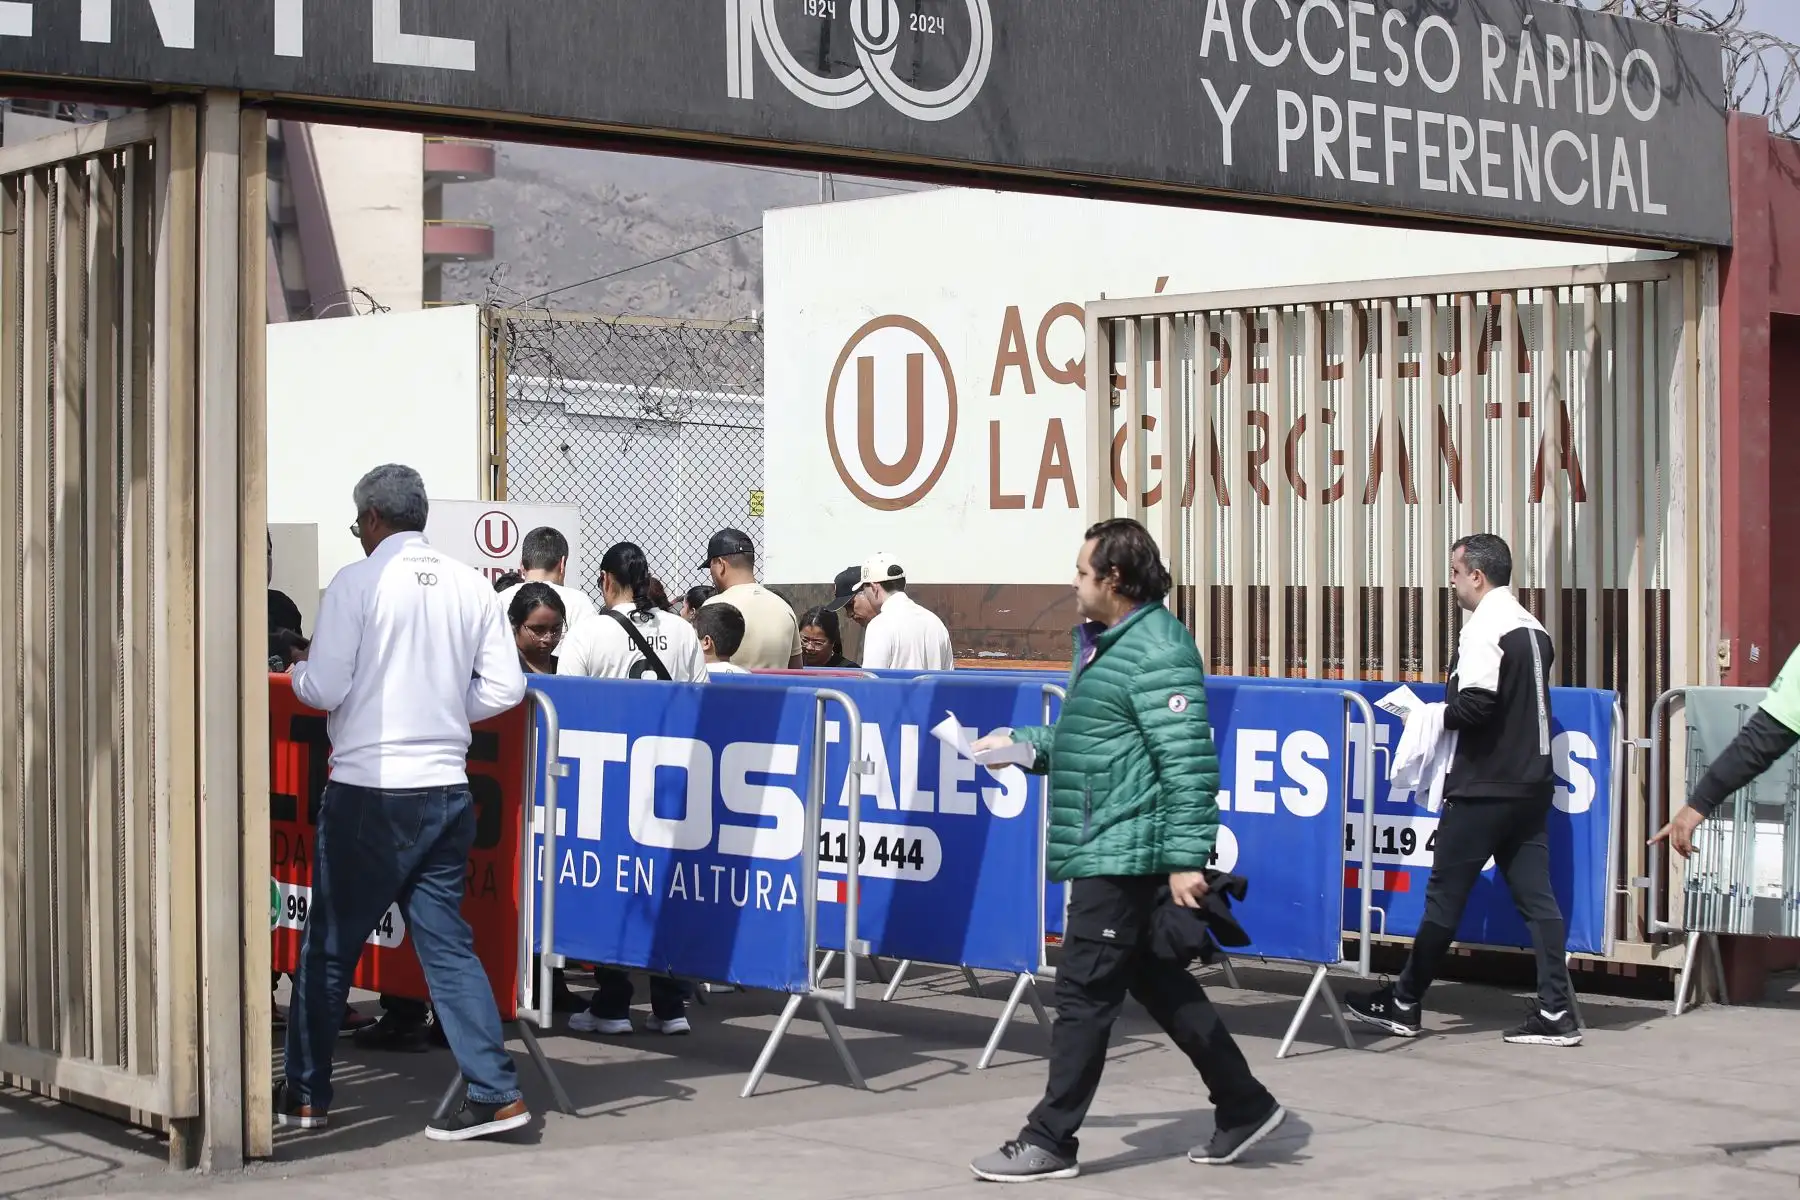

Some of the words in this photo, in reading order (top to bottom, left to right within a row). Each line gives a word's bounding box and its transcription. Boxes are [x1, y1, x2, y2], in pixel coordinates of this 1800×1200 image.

[803, 0, 836, 19] 1924
[909, 13, 945, 35] 2024
[1200, 0, 1460, 93] ACCESO
[1481, 15, 1661, 121] RÁPIDO
[1201, 78, 1251, 166] Y
[1277, 90, 1668, 216] PREFERENCIAL
[856, 353, 924, 486] U
[990, 418, 1080, 509] LA
[484, 519, 509, 554] U
[414, 571, 438, 586] 100
[628, 635, 668, 652] DRIS
[873, 836, 924, 871] 444
[616, 854, 654, 896] EN
[668, 861, 798, 912] ALTURA
